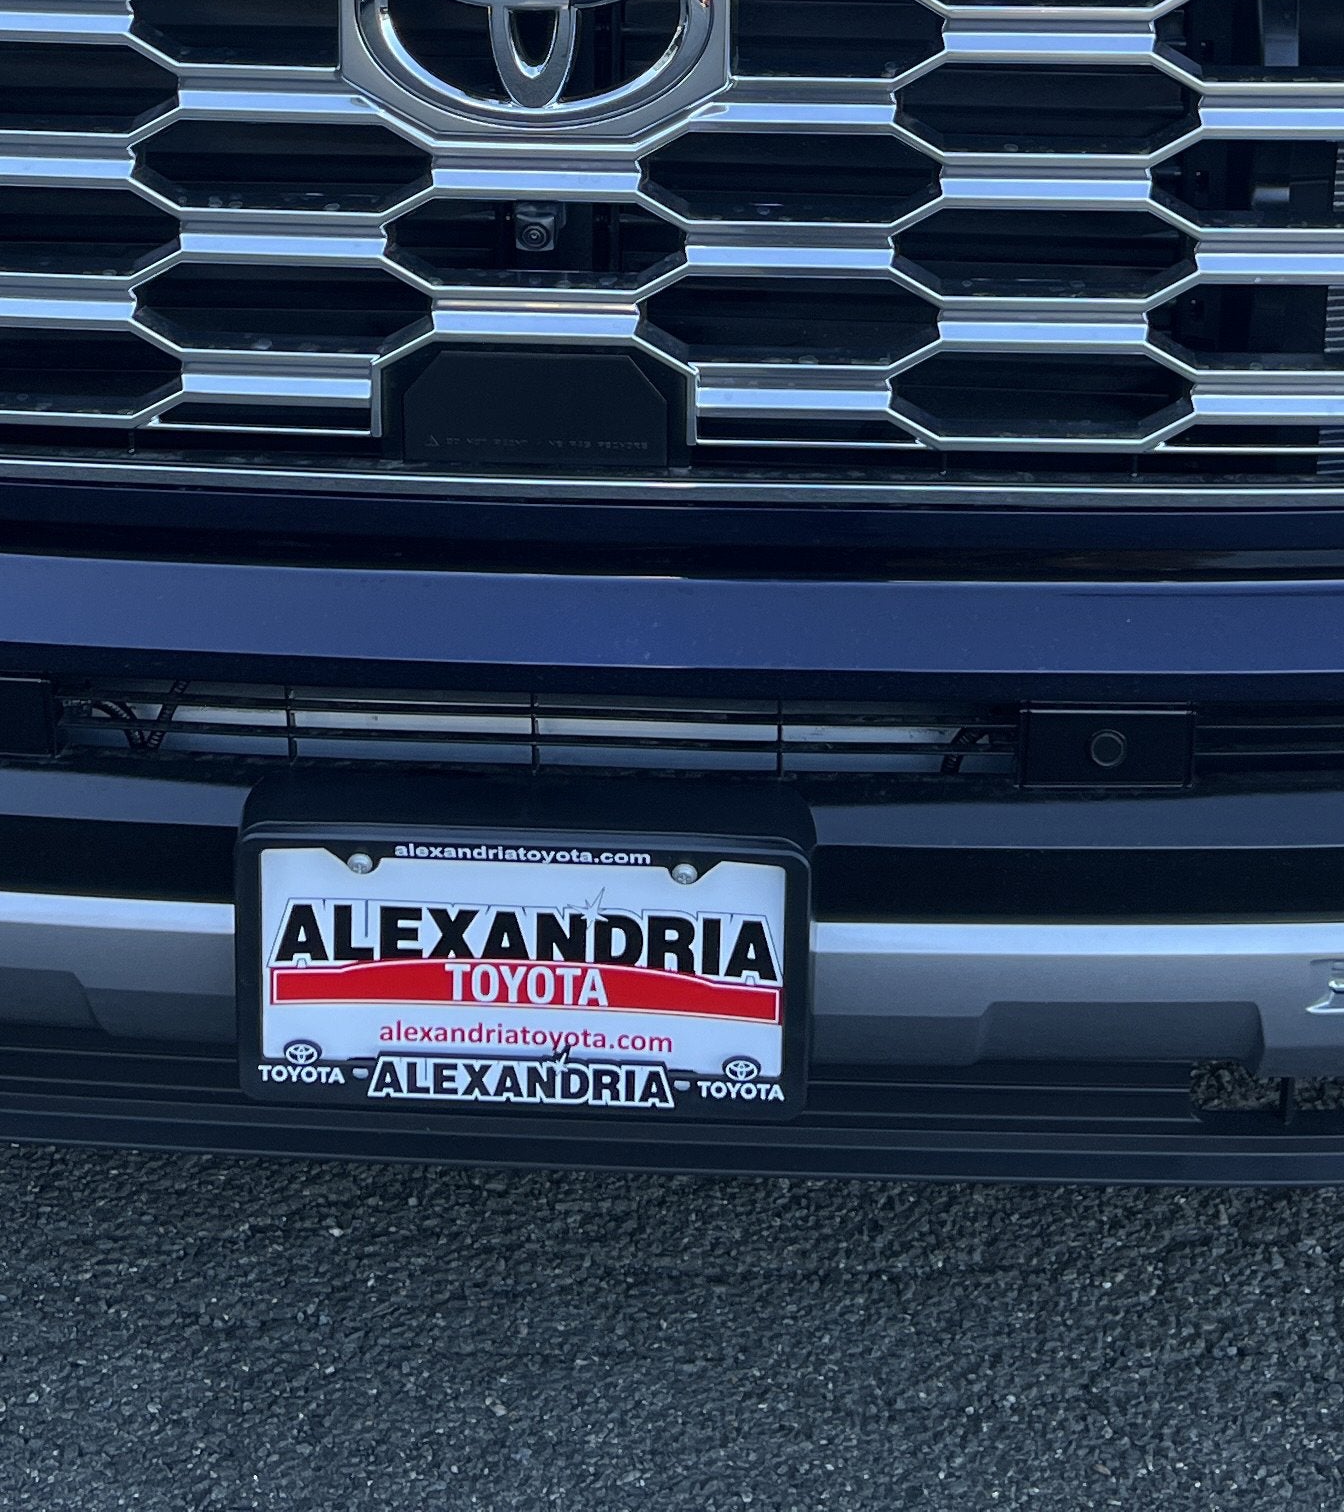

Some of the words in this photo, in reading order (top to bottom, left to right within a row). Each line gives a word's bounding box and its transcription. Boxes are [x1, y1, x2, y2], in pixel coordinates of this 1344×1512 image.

[394, 843, 652, 865] alexandriatoyota.com
[275, 903, 778, 982] ALEXANDRIA
[444, 962, 609, 1008] TOYOTA
[379, 1019, 673, 1053] alexandriatoyota.com
[258, 1064, 346, 1085] TOYOTA
[370, 1057, 673, 1107] ALEXANDRIA
[697, 1080, 785, 1102] TOYOTA
